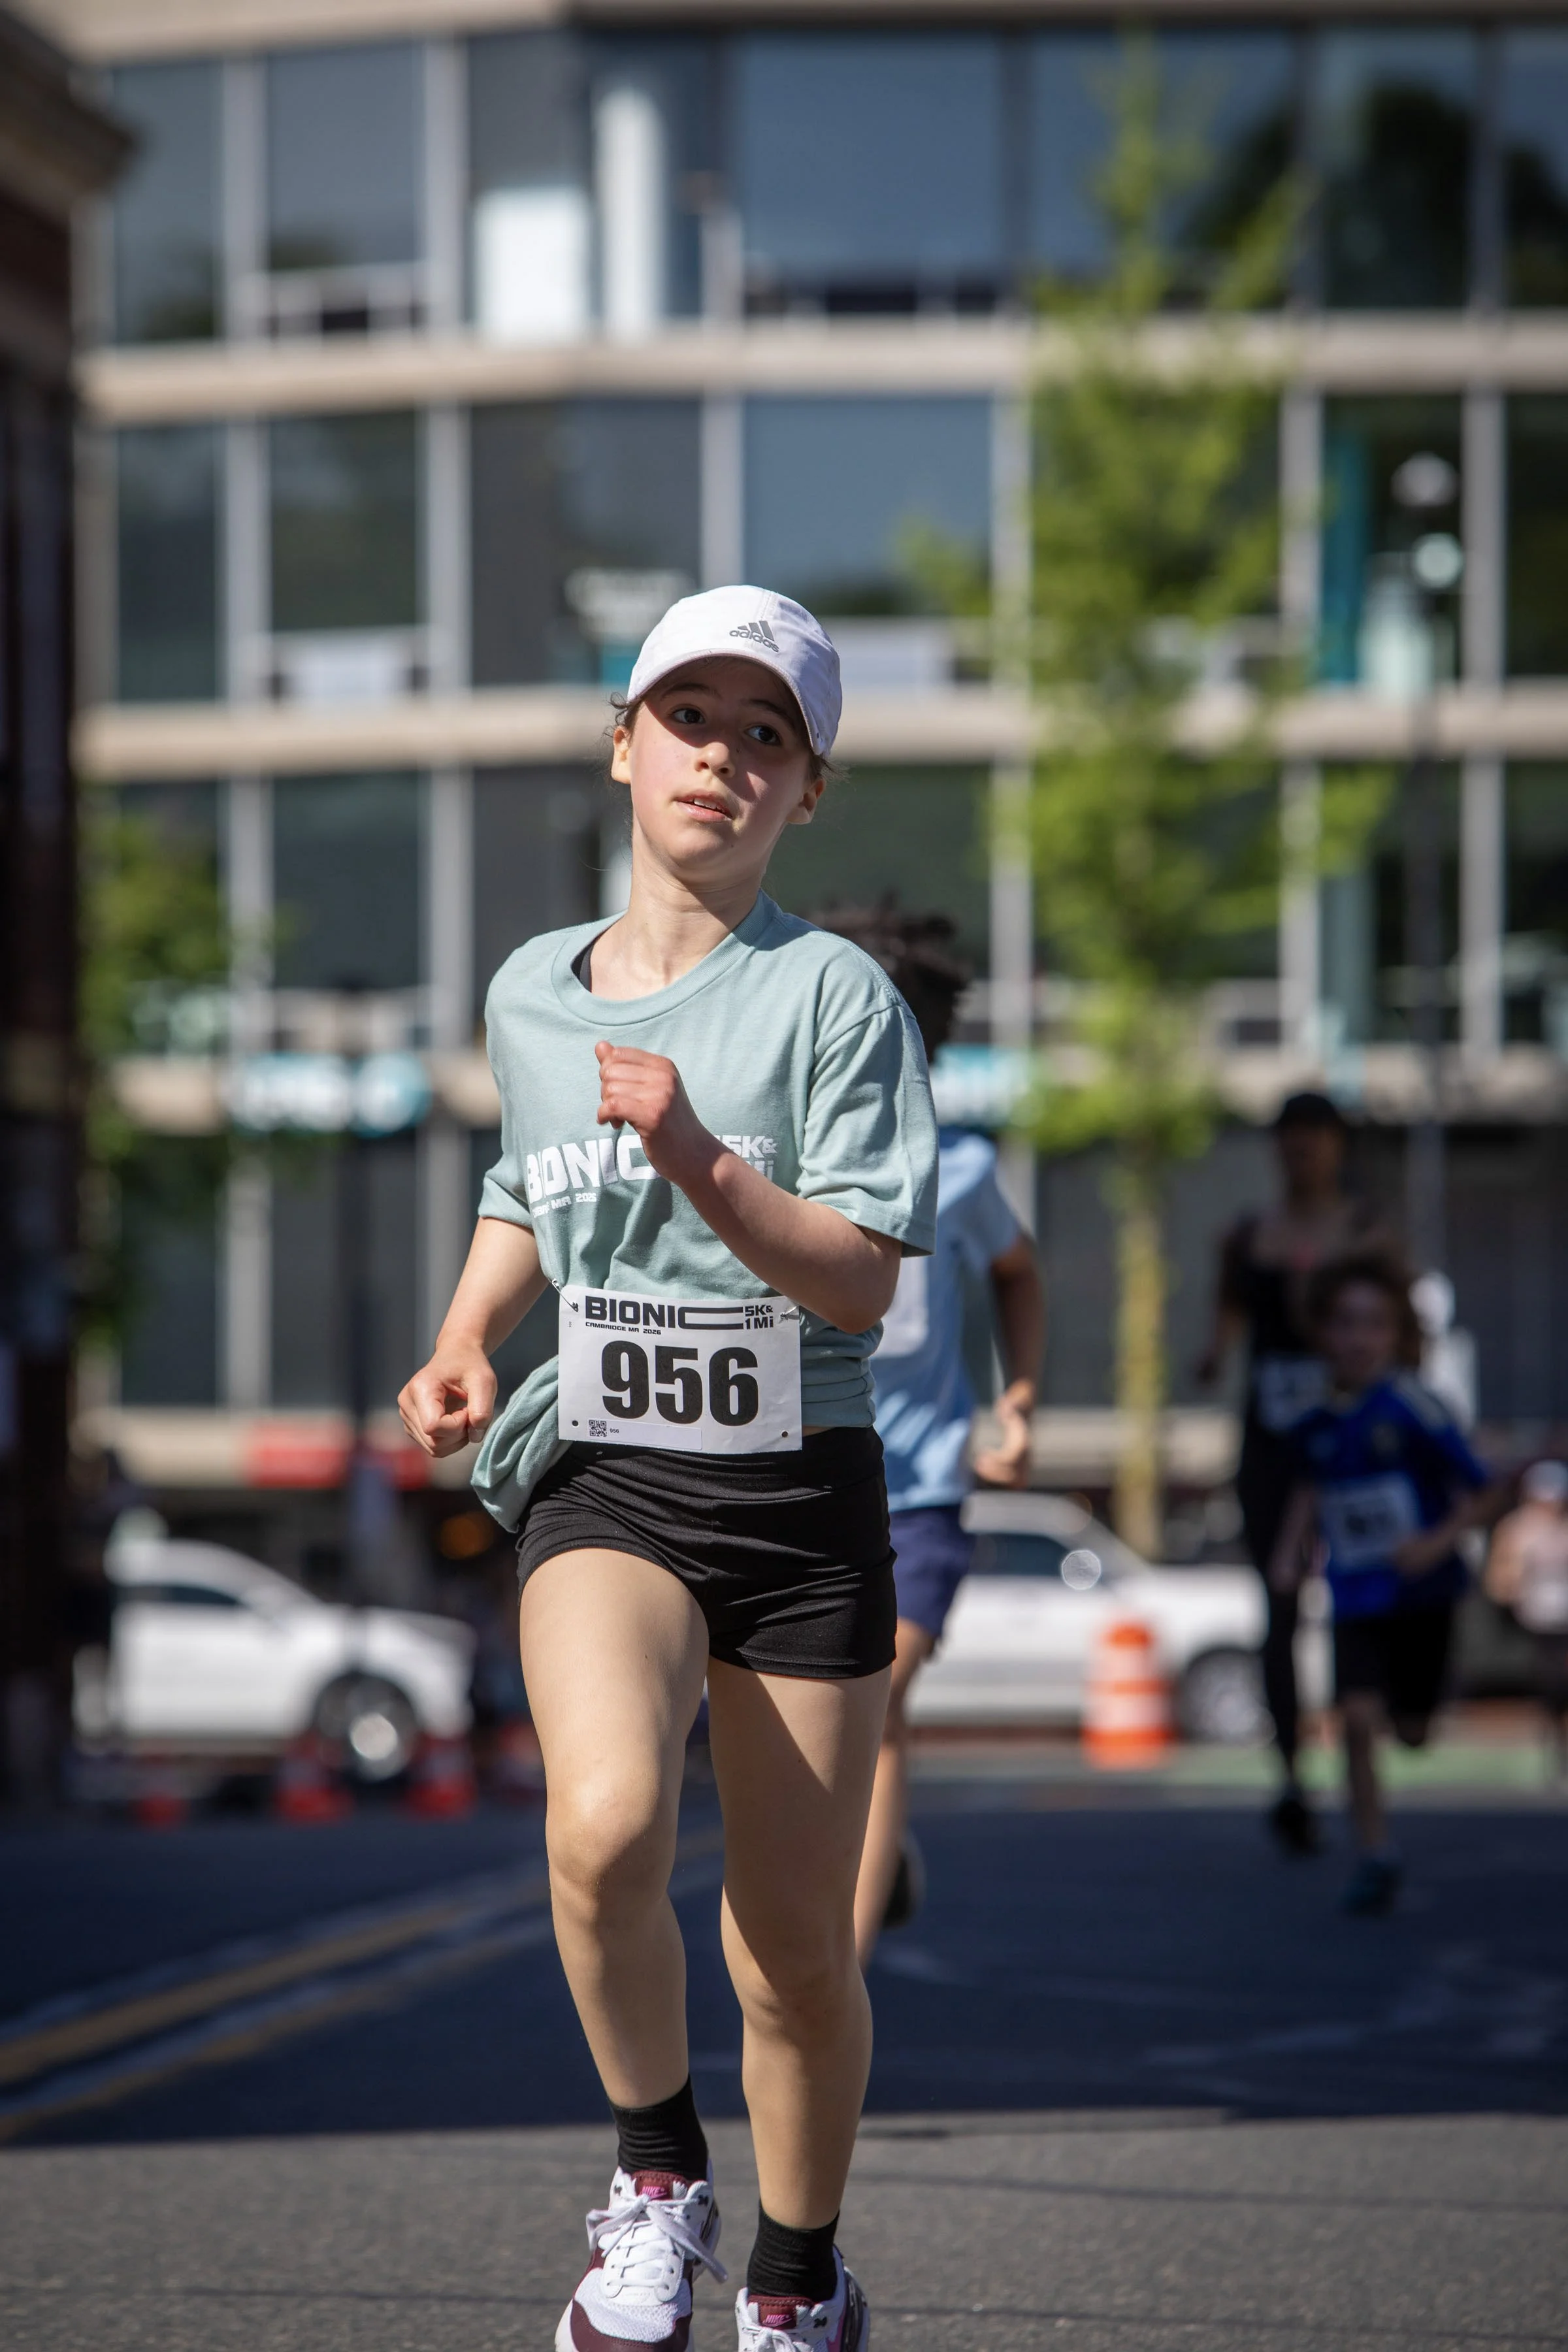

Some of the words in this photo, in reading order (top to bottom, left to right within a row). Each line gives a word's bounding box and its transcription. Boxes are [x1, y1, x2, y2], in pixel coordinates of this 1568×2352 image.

[729, 630, 779, 653] adidas
[585, 1296, 743, 1330] BIONIC
[745, 1305, 774, 1316] 5K&
[585, 1322, 626, 1331] CAMBRIDGE
[602, 1340, 759, 1426] 956
[765, 2315, 785, 2324] NIKE
